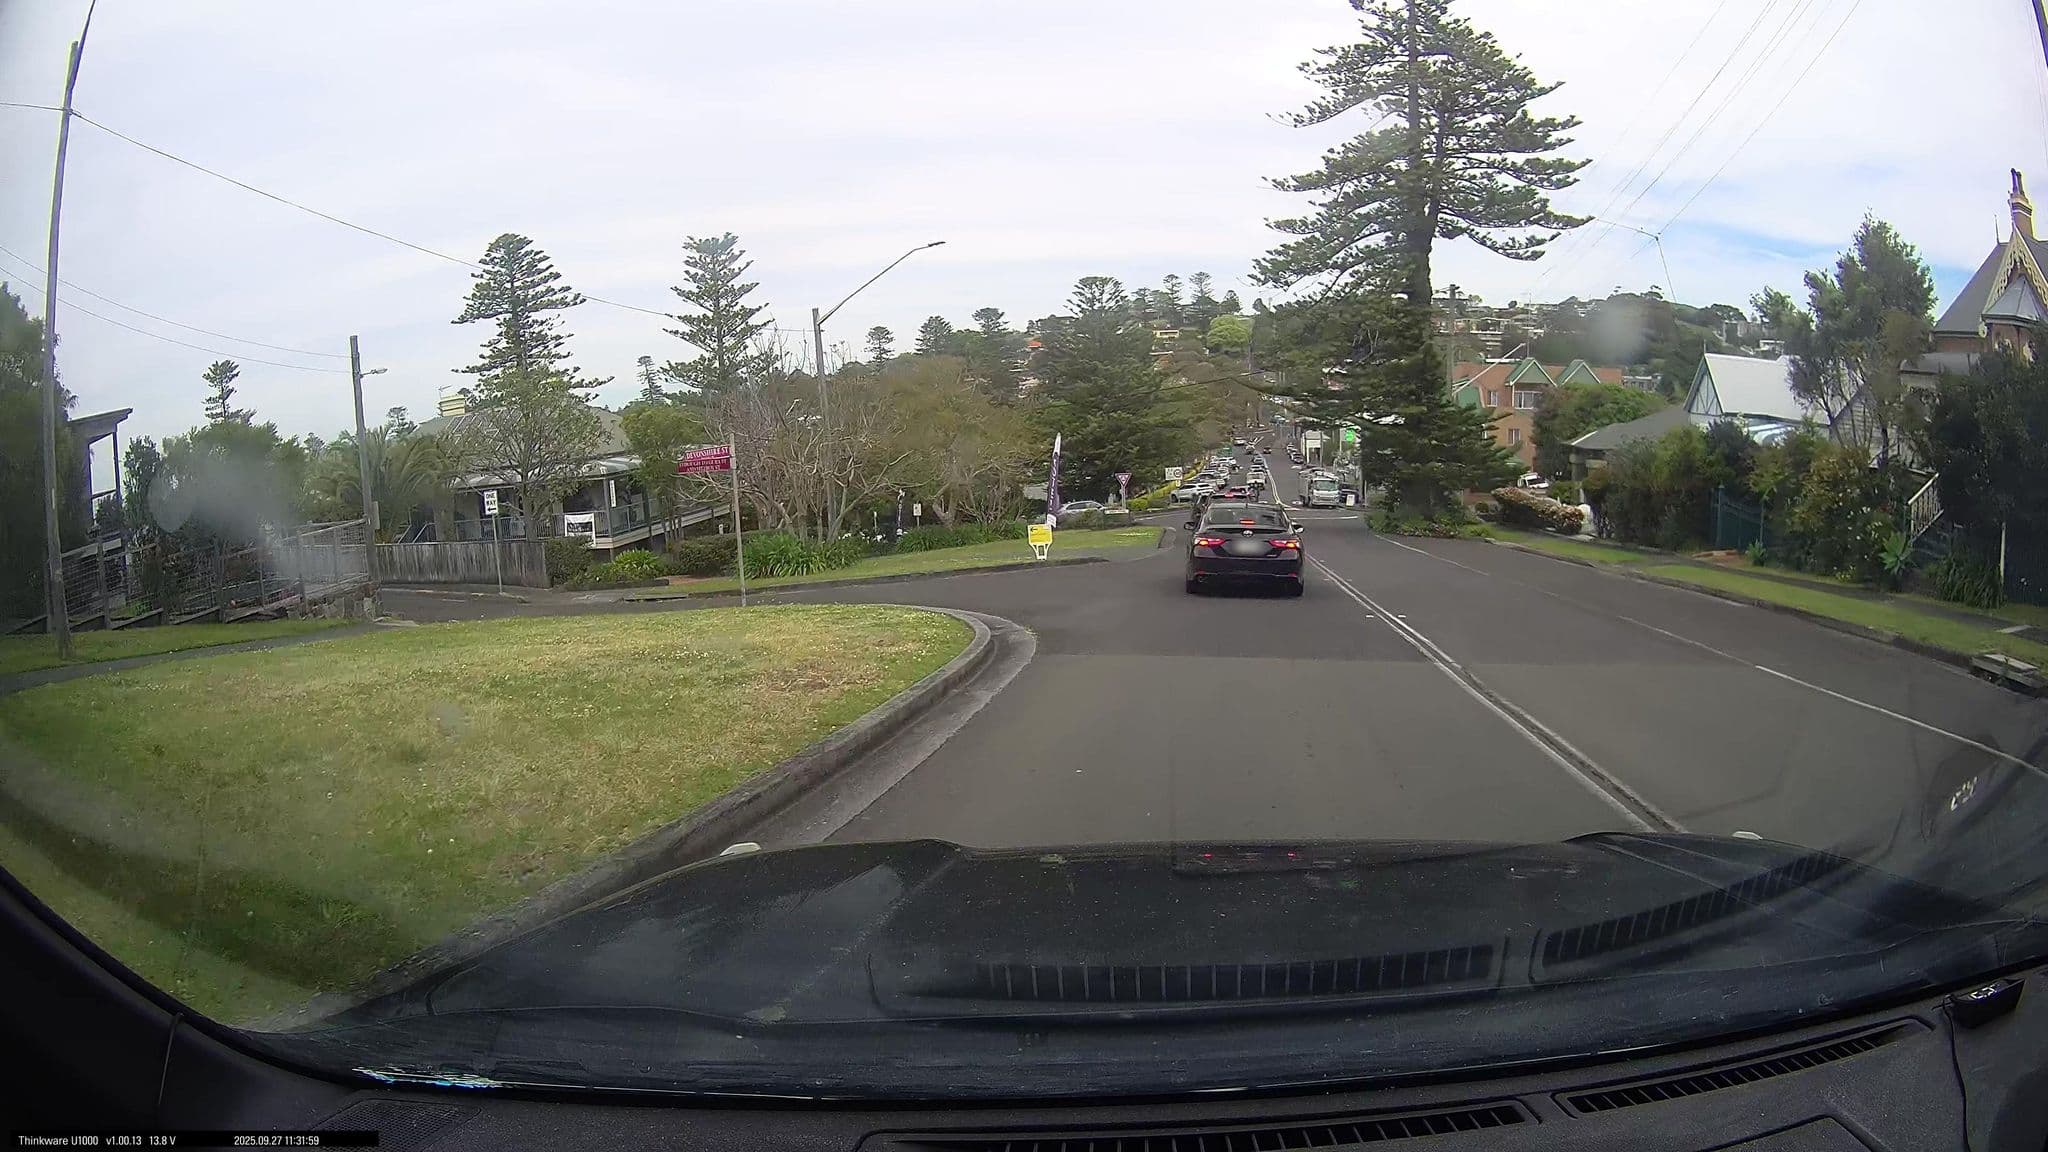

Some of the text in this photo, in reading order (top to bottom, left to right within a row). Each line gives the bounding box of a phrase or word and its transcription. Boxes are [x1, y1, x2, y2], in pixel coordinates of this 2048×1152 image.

[686, 447, 729, 460] DEVONSHIRE ST
[486, 492, 496, 500] ONE
